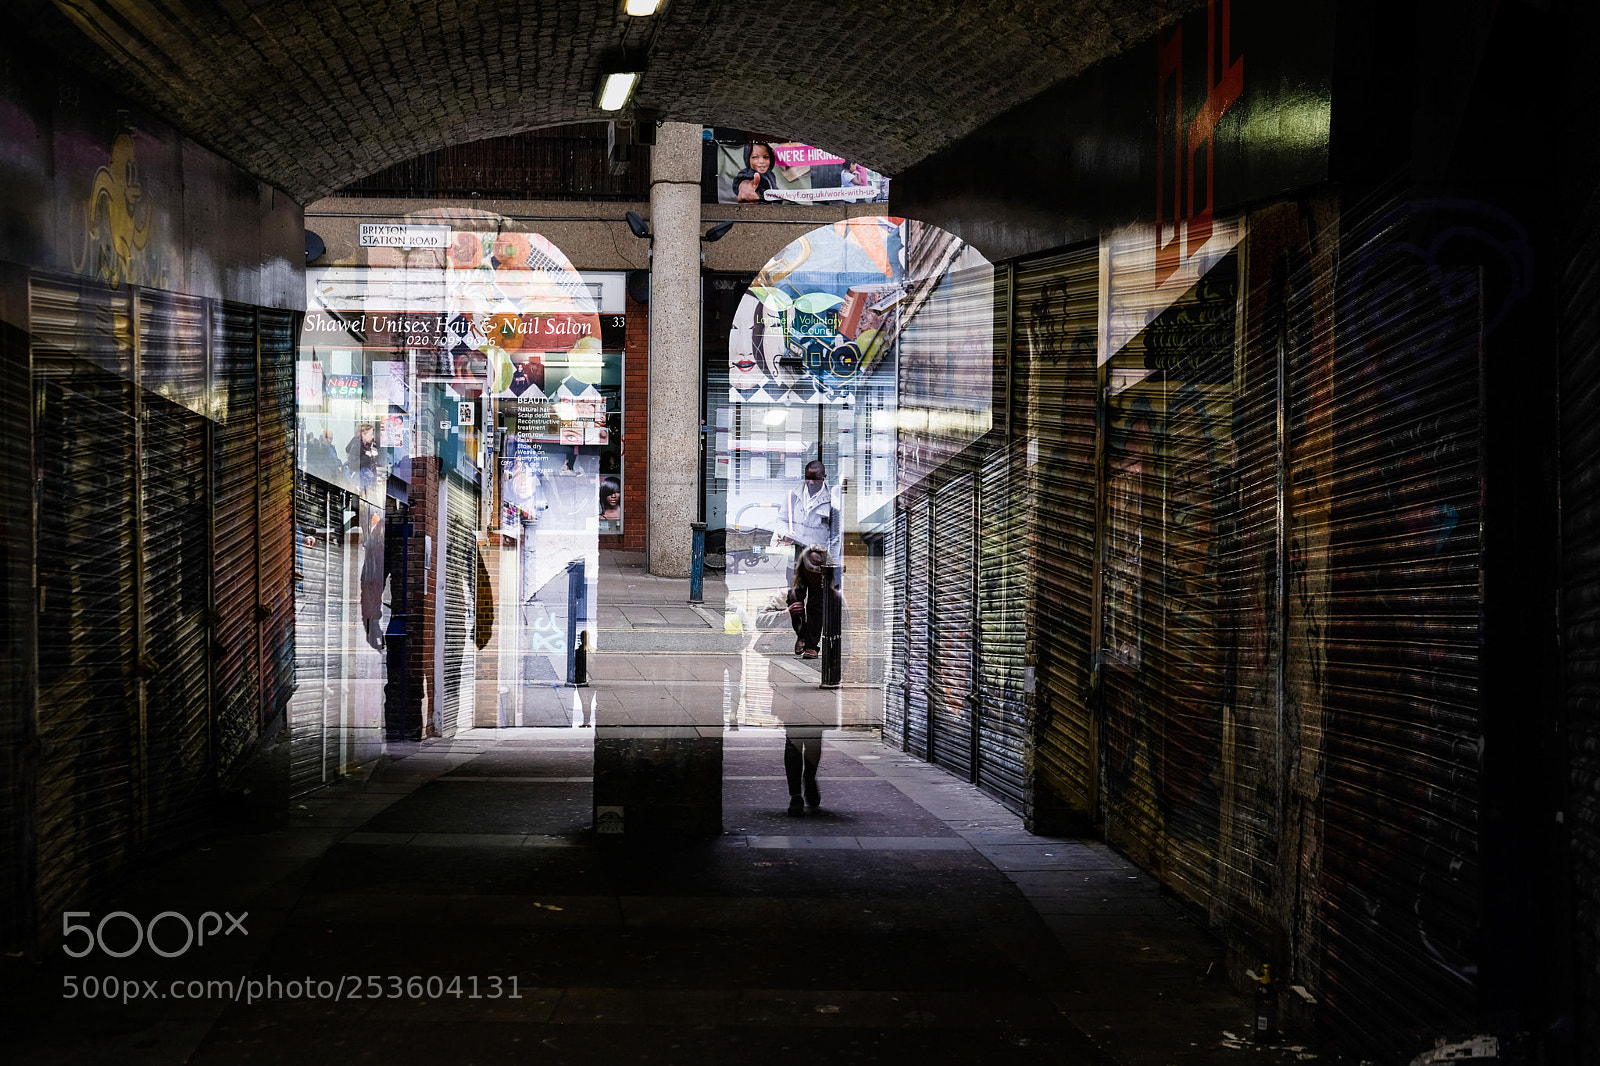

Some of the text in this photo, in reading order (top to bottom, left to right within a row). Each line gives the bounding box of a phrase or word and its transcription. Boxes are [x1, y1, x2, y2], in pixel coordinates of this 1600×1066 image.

[777, 149, 805, 162] WE'RE
[362, 226, 407, 235] BRIXTON
[362, 235, 438, 245] STATION ROAD
[304, 314, 592, 335] Shawel Unisex Hair & Nail Salon
[612, 316, 626, 328] 33
[799, 314, 843, 327] Voluntary
[800, 324, 836, 334] Council
[406, 335, 429, 345] 020
[327, 378, 359, 387] Nails
[339, 386, 363, 395] Spa
[517, 396, 551, 404] BEAUTY
